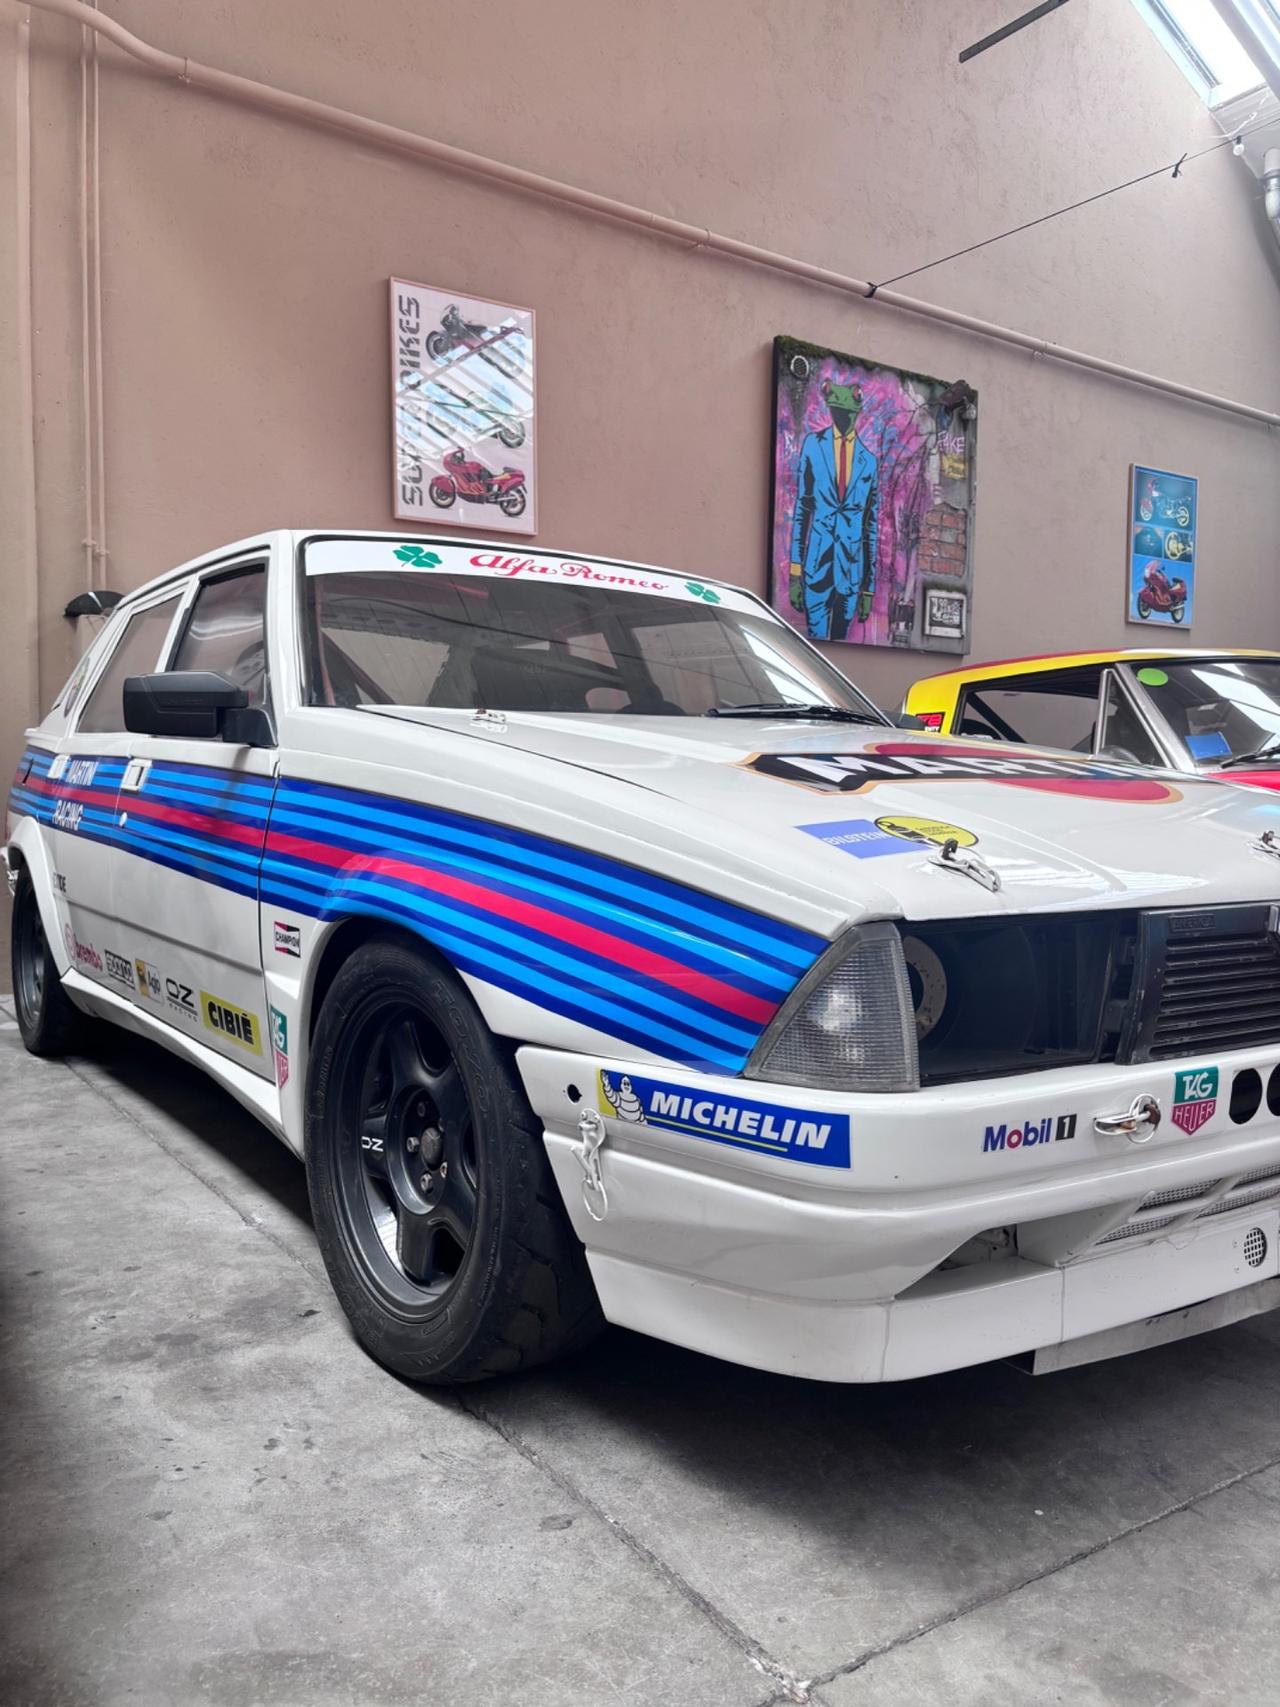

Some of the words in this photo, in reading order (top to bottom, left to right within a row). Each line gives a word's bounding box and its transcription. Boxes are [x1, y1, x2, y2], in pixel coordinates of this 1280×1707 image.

[469, 554, 557, 577] Alfa
[559, 562, 669, 591] Romeo
[165, 977, 195, 1008] OZ
[1182, 1071, 1213, 1101] TAG
[650, 1090, 832, 1150] MICHELIN
[1174, 1101, 1215, 1133] HEUER
[361, 1136, 384, 1152] OZ
[983, 1117, 1053, 1153] Mobil
